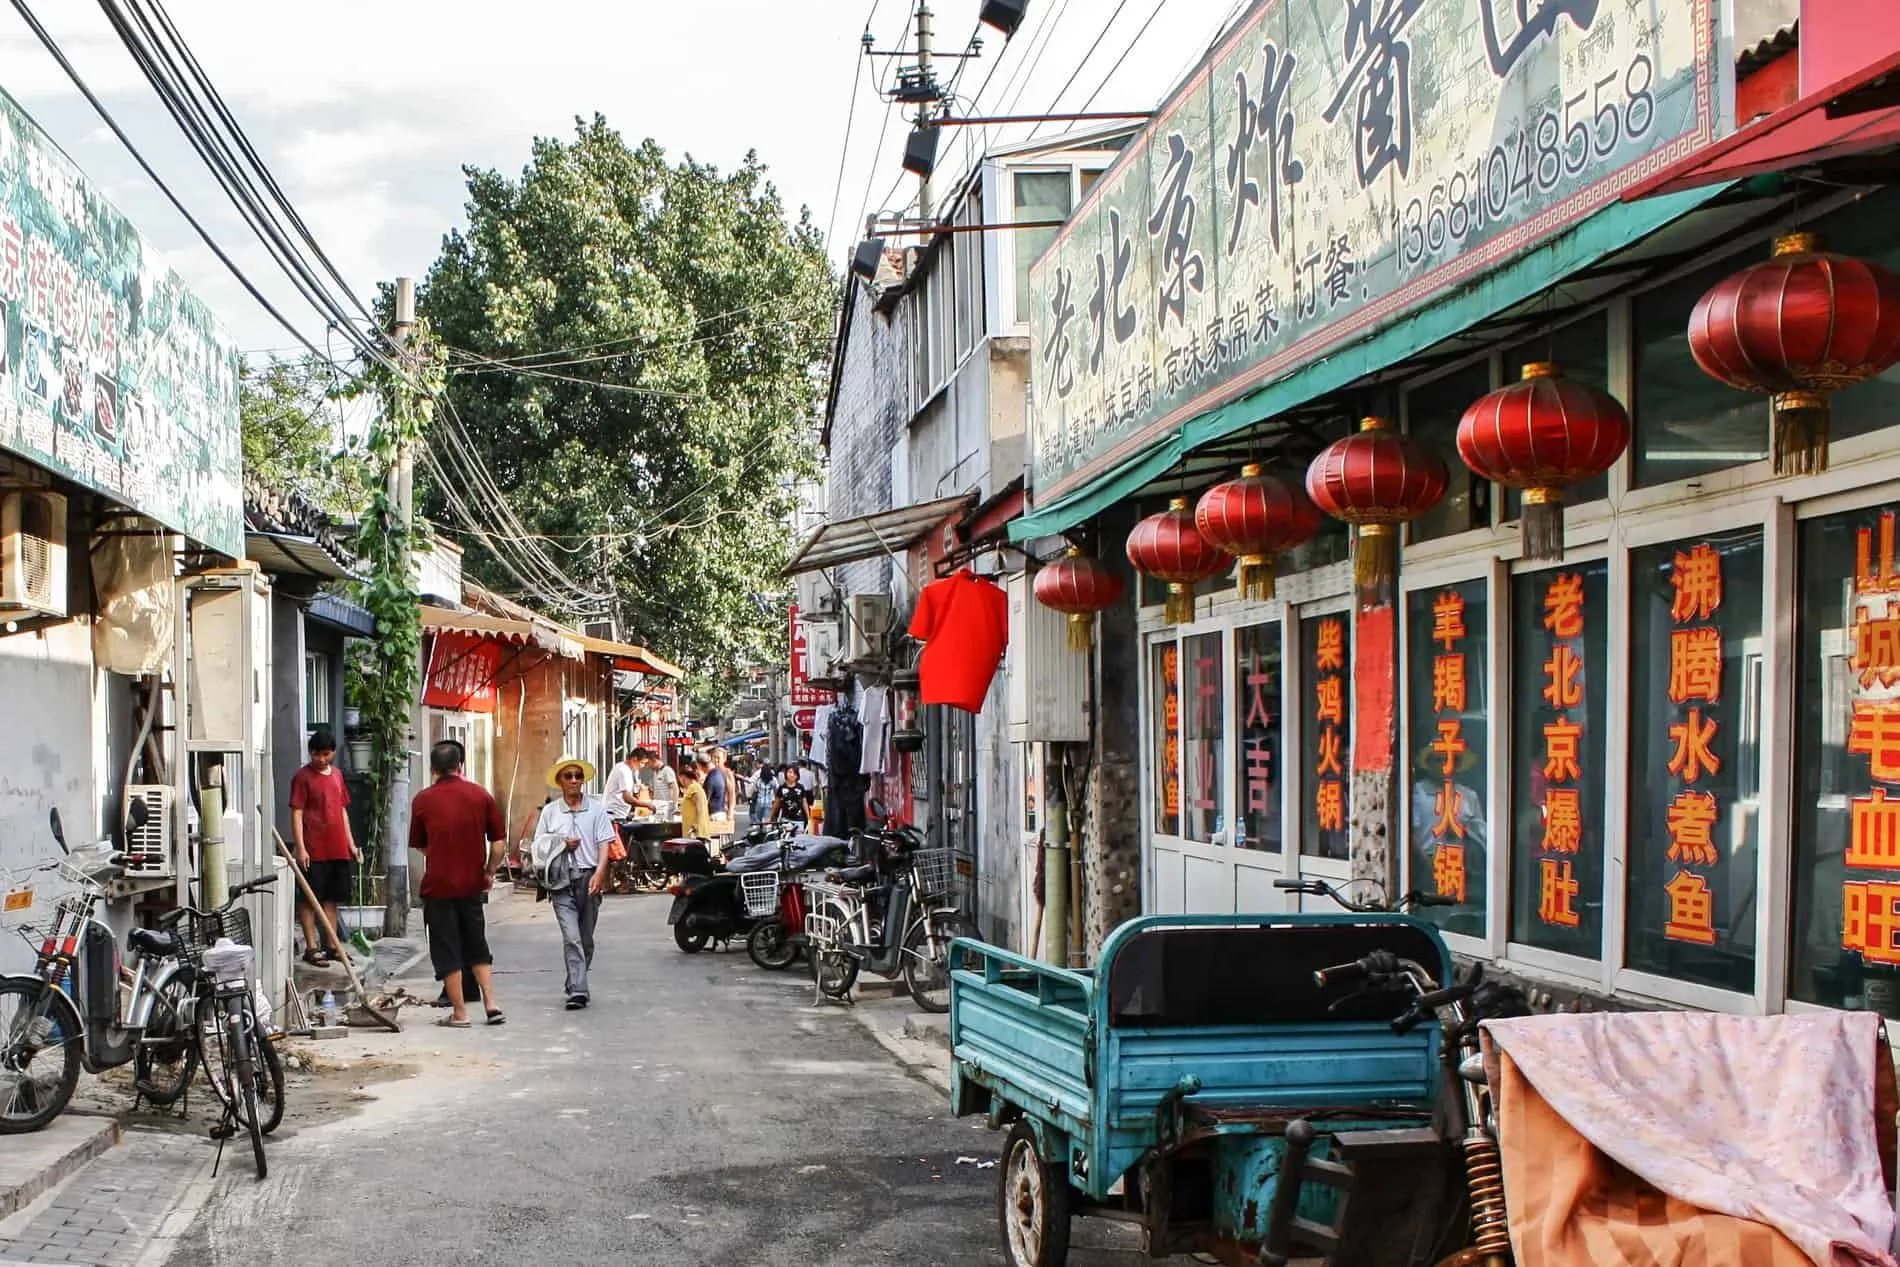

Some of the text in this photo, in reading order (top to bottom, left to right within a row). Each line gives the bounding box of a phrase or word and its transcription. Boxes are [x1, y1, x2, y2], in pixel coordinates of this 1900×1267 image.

[1104, 364, 1152, 432] 麻豆腐
[1163, 282, 1279, 395] 京味家常菜
[1393, 54, 1654, 271] 13681048558
[1246, 655, 1273, 816] 大吉
[1316, 618, 1343, 832] 柴鸡火锅
[1539, 571, 1584, 928] 老北京爆肚
[1664, 543, 1722, 946] 沸腾水煮鱼
